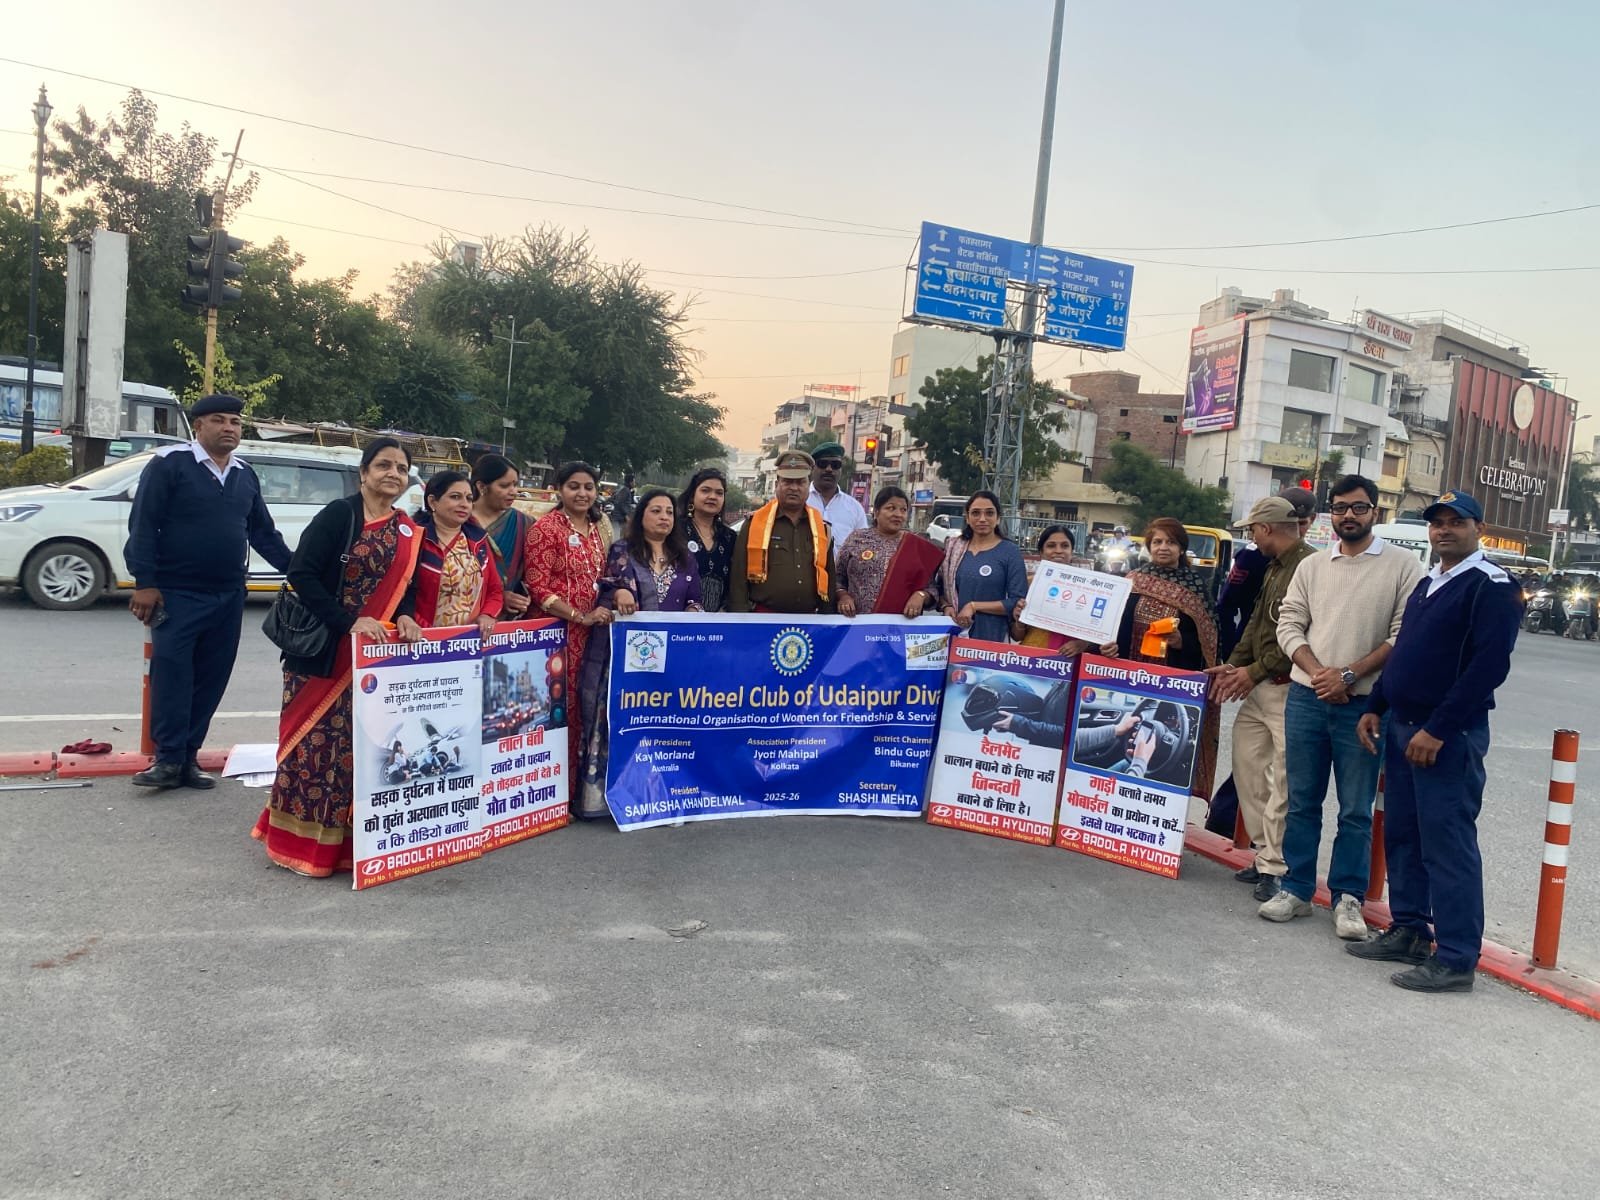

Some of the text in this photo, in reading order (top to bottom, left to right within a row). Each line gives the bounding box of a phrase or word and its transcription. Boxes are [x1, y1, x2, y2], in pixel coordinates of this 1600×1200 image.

[1023, 262, 1028, 270] 2
[943, 284, 998, 304] अहमदाबाद
[1058, 302, 1092, 324] जोधपुर
[1480, 465, 1546, 496] CELEBRATION
[362, 638, 480, 660] यातायात पुलिस, उदयपुर
[510, 628, 564, 648] पुलिस, उदयपुर
[671, 634, 706, 642] Charter No.
[956, 646, 1072, 676] यातायात पुलिस, उदयपुर
[388, 676, 460, 694] सड़क दुर्घटना में घायल
[1084, 662, 1206, 696] यातायात पुलिस, उदयपुर
[384, 694, 394, 704] को
[395, 692, 410, 706] तुरंत
[412, 690, 442, 702] अस्पताल
[620, 688, 672, 710] Inner
[678, 685, 744, 709] Wheel
[750, 684, 790, 708] Club
[794, 684, 814, 706] of
[819, 684, 902, 711] Udaipur
[630, 714, 700, 726] International
[702, 713, 767, 727] Organisation
[770, 712, 780, 723] of
[782, 712, 820, 724] Women
[822, 712, 838, 722] for
[840, 712, 894, 724] Friendship
[896, 710, 906, 720] &
[498, 734, 523, 754] लाल
[654, 739, 691, 747] President
[747, 737, 826, 746] Association President
[874, 747, 903, 756] Bindu
[980, 736, 1022, 760] हैलमेट
[490, 750, 551, 774] खतरे की पहचान
[635, 750, 696, 763] Kay Morland
[754, 750, 818, 762] Jyoti Mahipal
[770, 763, 800, 771] Kolkata
[890, 760, 920, 768] Bikaner
[652, 764, 680, 772] Australia
[944, 754, 1056, 784] चालान बचाने के लिए नहीं
[482, 763, 560, 796] इसे तोड़कर क्यों देते हो
[670, 786, 700, 795] President
[859, 782, 896, 791] Secretary
[971, 771, 1022, 797] जिन्दगी
[1089, 774, 1167, 806] गाड़ी चलाते समय
[371, 774, 474, 808] सड़क दुर्घटना में घायल
[764, 792, 800, 802] 2025-26
[838, 792, 918, 806] SHASHI MEHTA
[625, 794, 745, 818] SAMIKSHA KHANDELWAL
[957, 792, 1031, 816] बचाने के लिए है।
[1066, 790, 1109, 814] मोबाईल
[1111, 805, 1124, 818] का
[1125, 810, 1150, 826] प्रयोग
[1152, 816, 1160, 828] न
[364, 814, 380, 833] को
[382, 808, 404, 834] तुरंत
[406, 802, 449, 824] अस्पताल
[494, 805, 568, 838] BADOLA HYUNDAI
[954, 809, 1052, 838] BADOLA HYUNDAI
[376, 816, 470, 850] न कि वीडियो बनाएं
[1080, 815, 1166, 846] इससे ध्यान भटकता है
[1082, 832, 1128, 854] BADOLA
[387, 846, 434, 870] BADOLA
